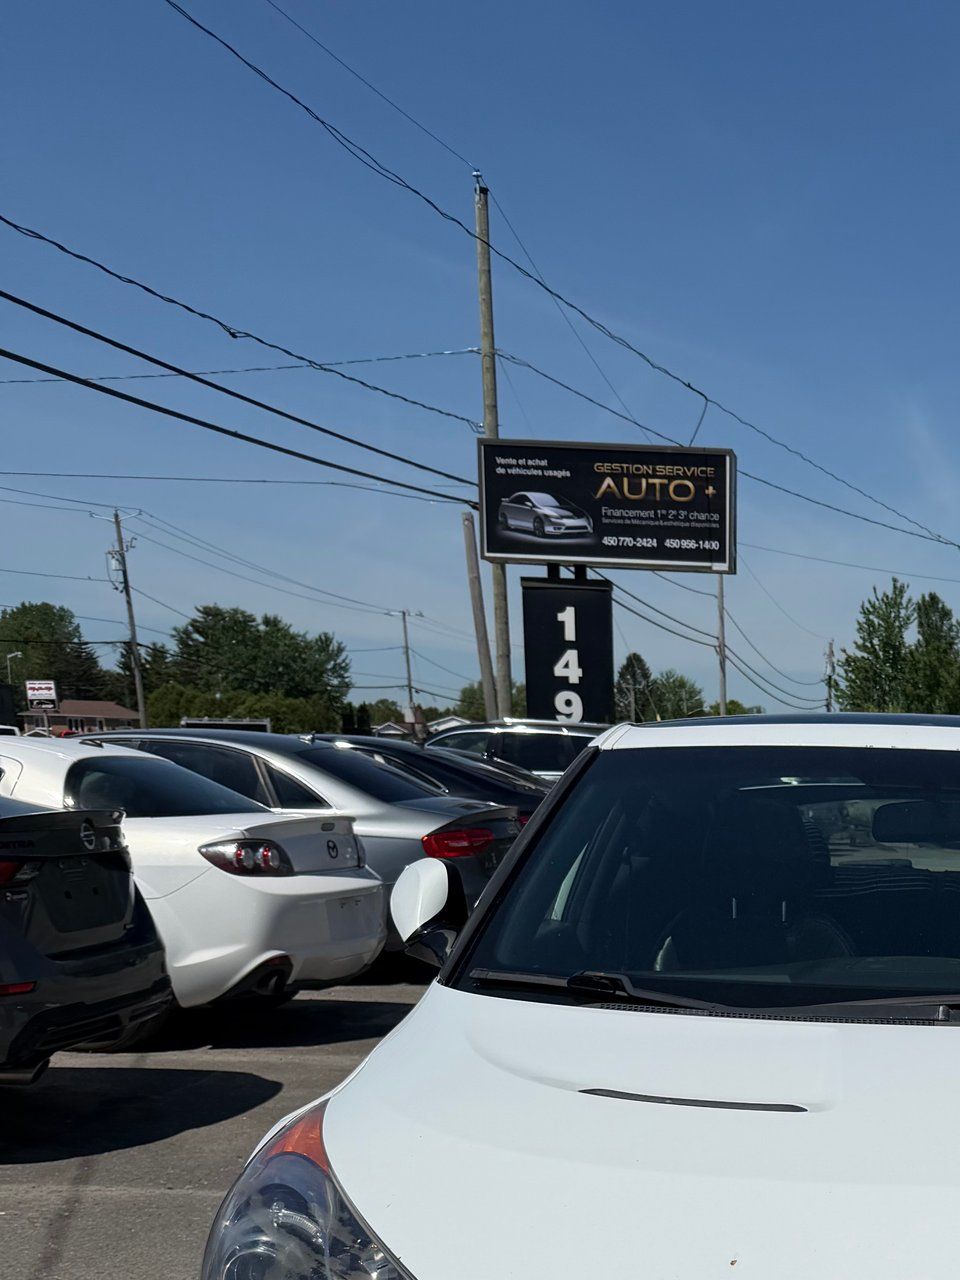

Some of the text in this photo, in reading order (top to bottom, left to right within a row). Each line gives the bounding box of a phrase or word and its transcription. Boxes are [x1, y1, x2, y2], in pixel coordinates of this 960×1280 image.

[495, 456, 548, 467] Vente et achat
[496, 466, 571, 478] de véhicules usagés
[593, 462, 715, 477] GESTION SERVICE
[594, 476, 696, 502] AUTO
[602, 506, 655, 518] Financement
[689, 511, 720, 521] chance
[602, 536, 658, 548] 450 770-2424
[664, 538, 681, 549] 450
